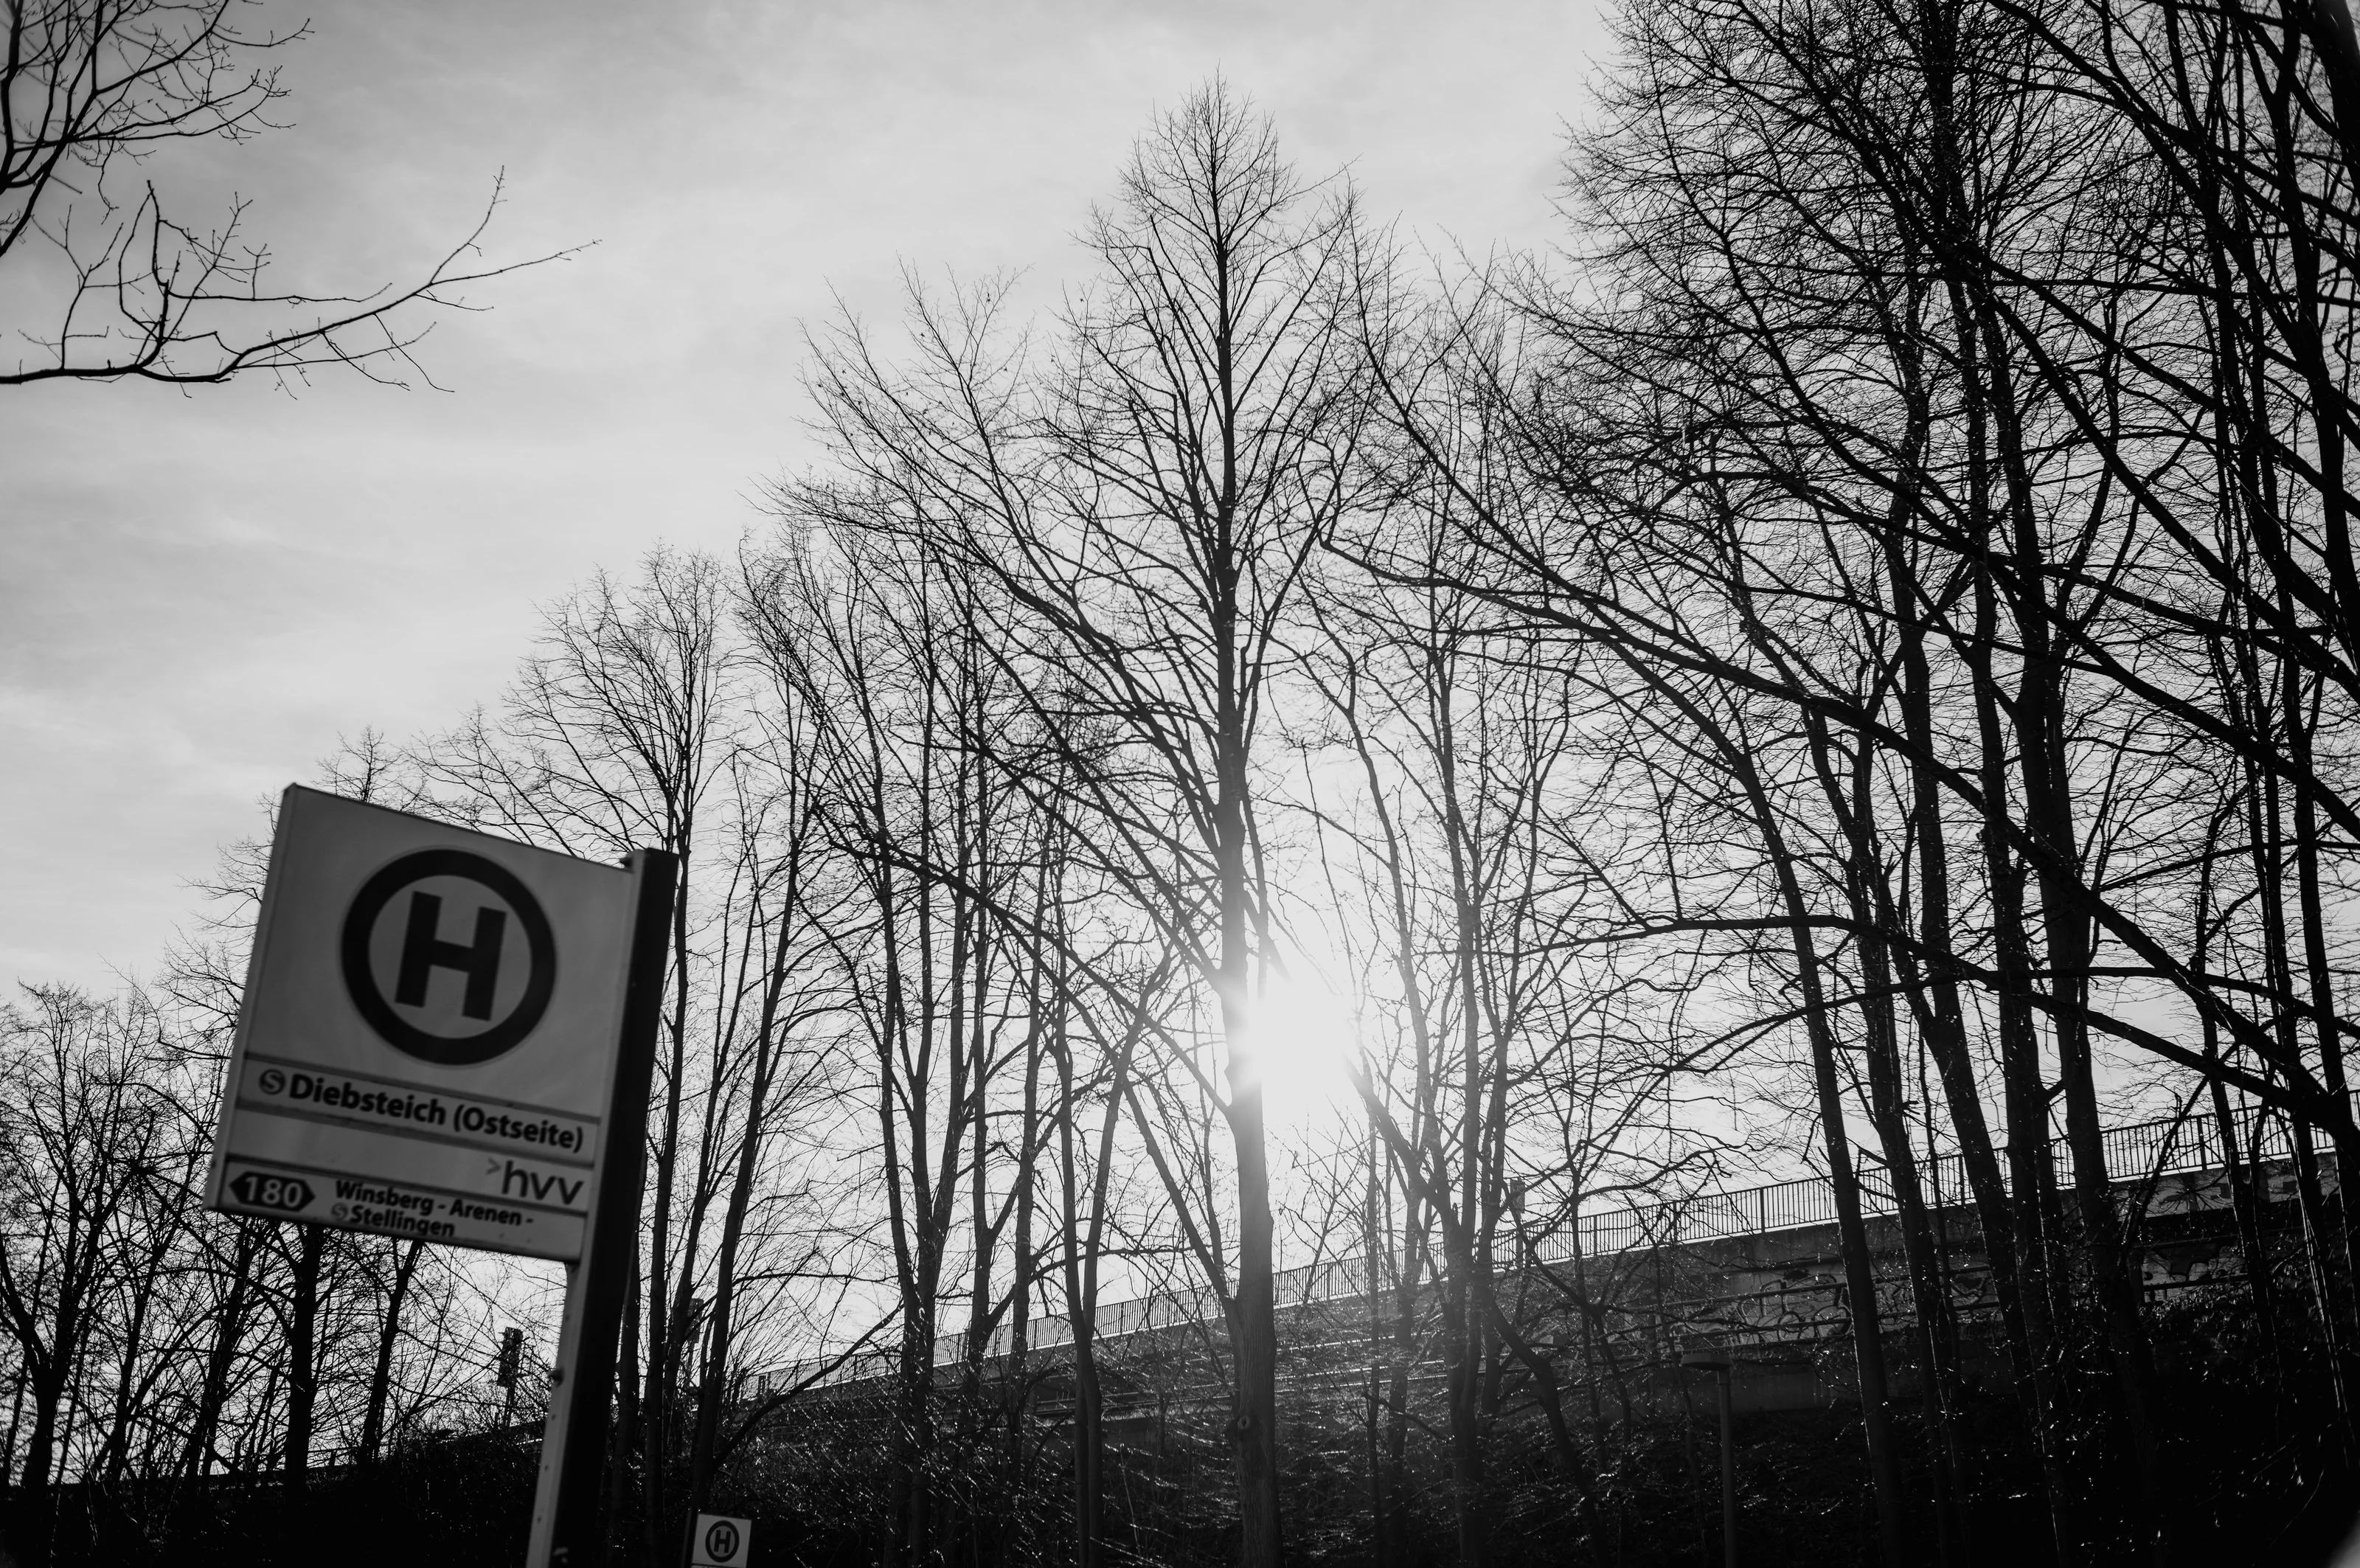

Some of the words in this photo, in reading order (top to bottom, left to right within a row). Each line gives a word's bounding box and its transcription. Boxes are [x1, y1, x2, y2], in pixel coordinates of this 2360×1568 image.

[395, 890, 507, 1021] H
[290, 1074, 445, 1125] Diebsteich
[454, 1104, 583, 1154] (Ostseite)
[244, 1175, 302, 1208] 180
[336, 1179, 434, 1215] Winsberg
[450, 1198, 521, 1226] Arenen
[351, 1204, 454, 1238] Stellingen
[714, 1530, 731, 1553] H
